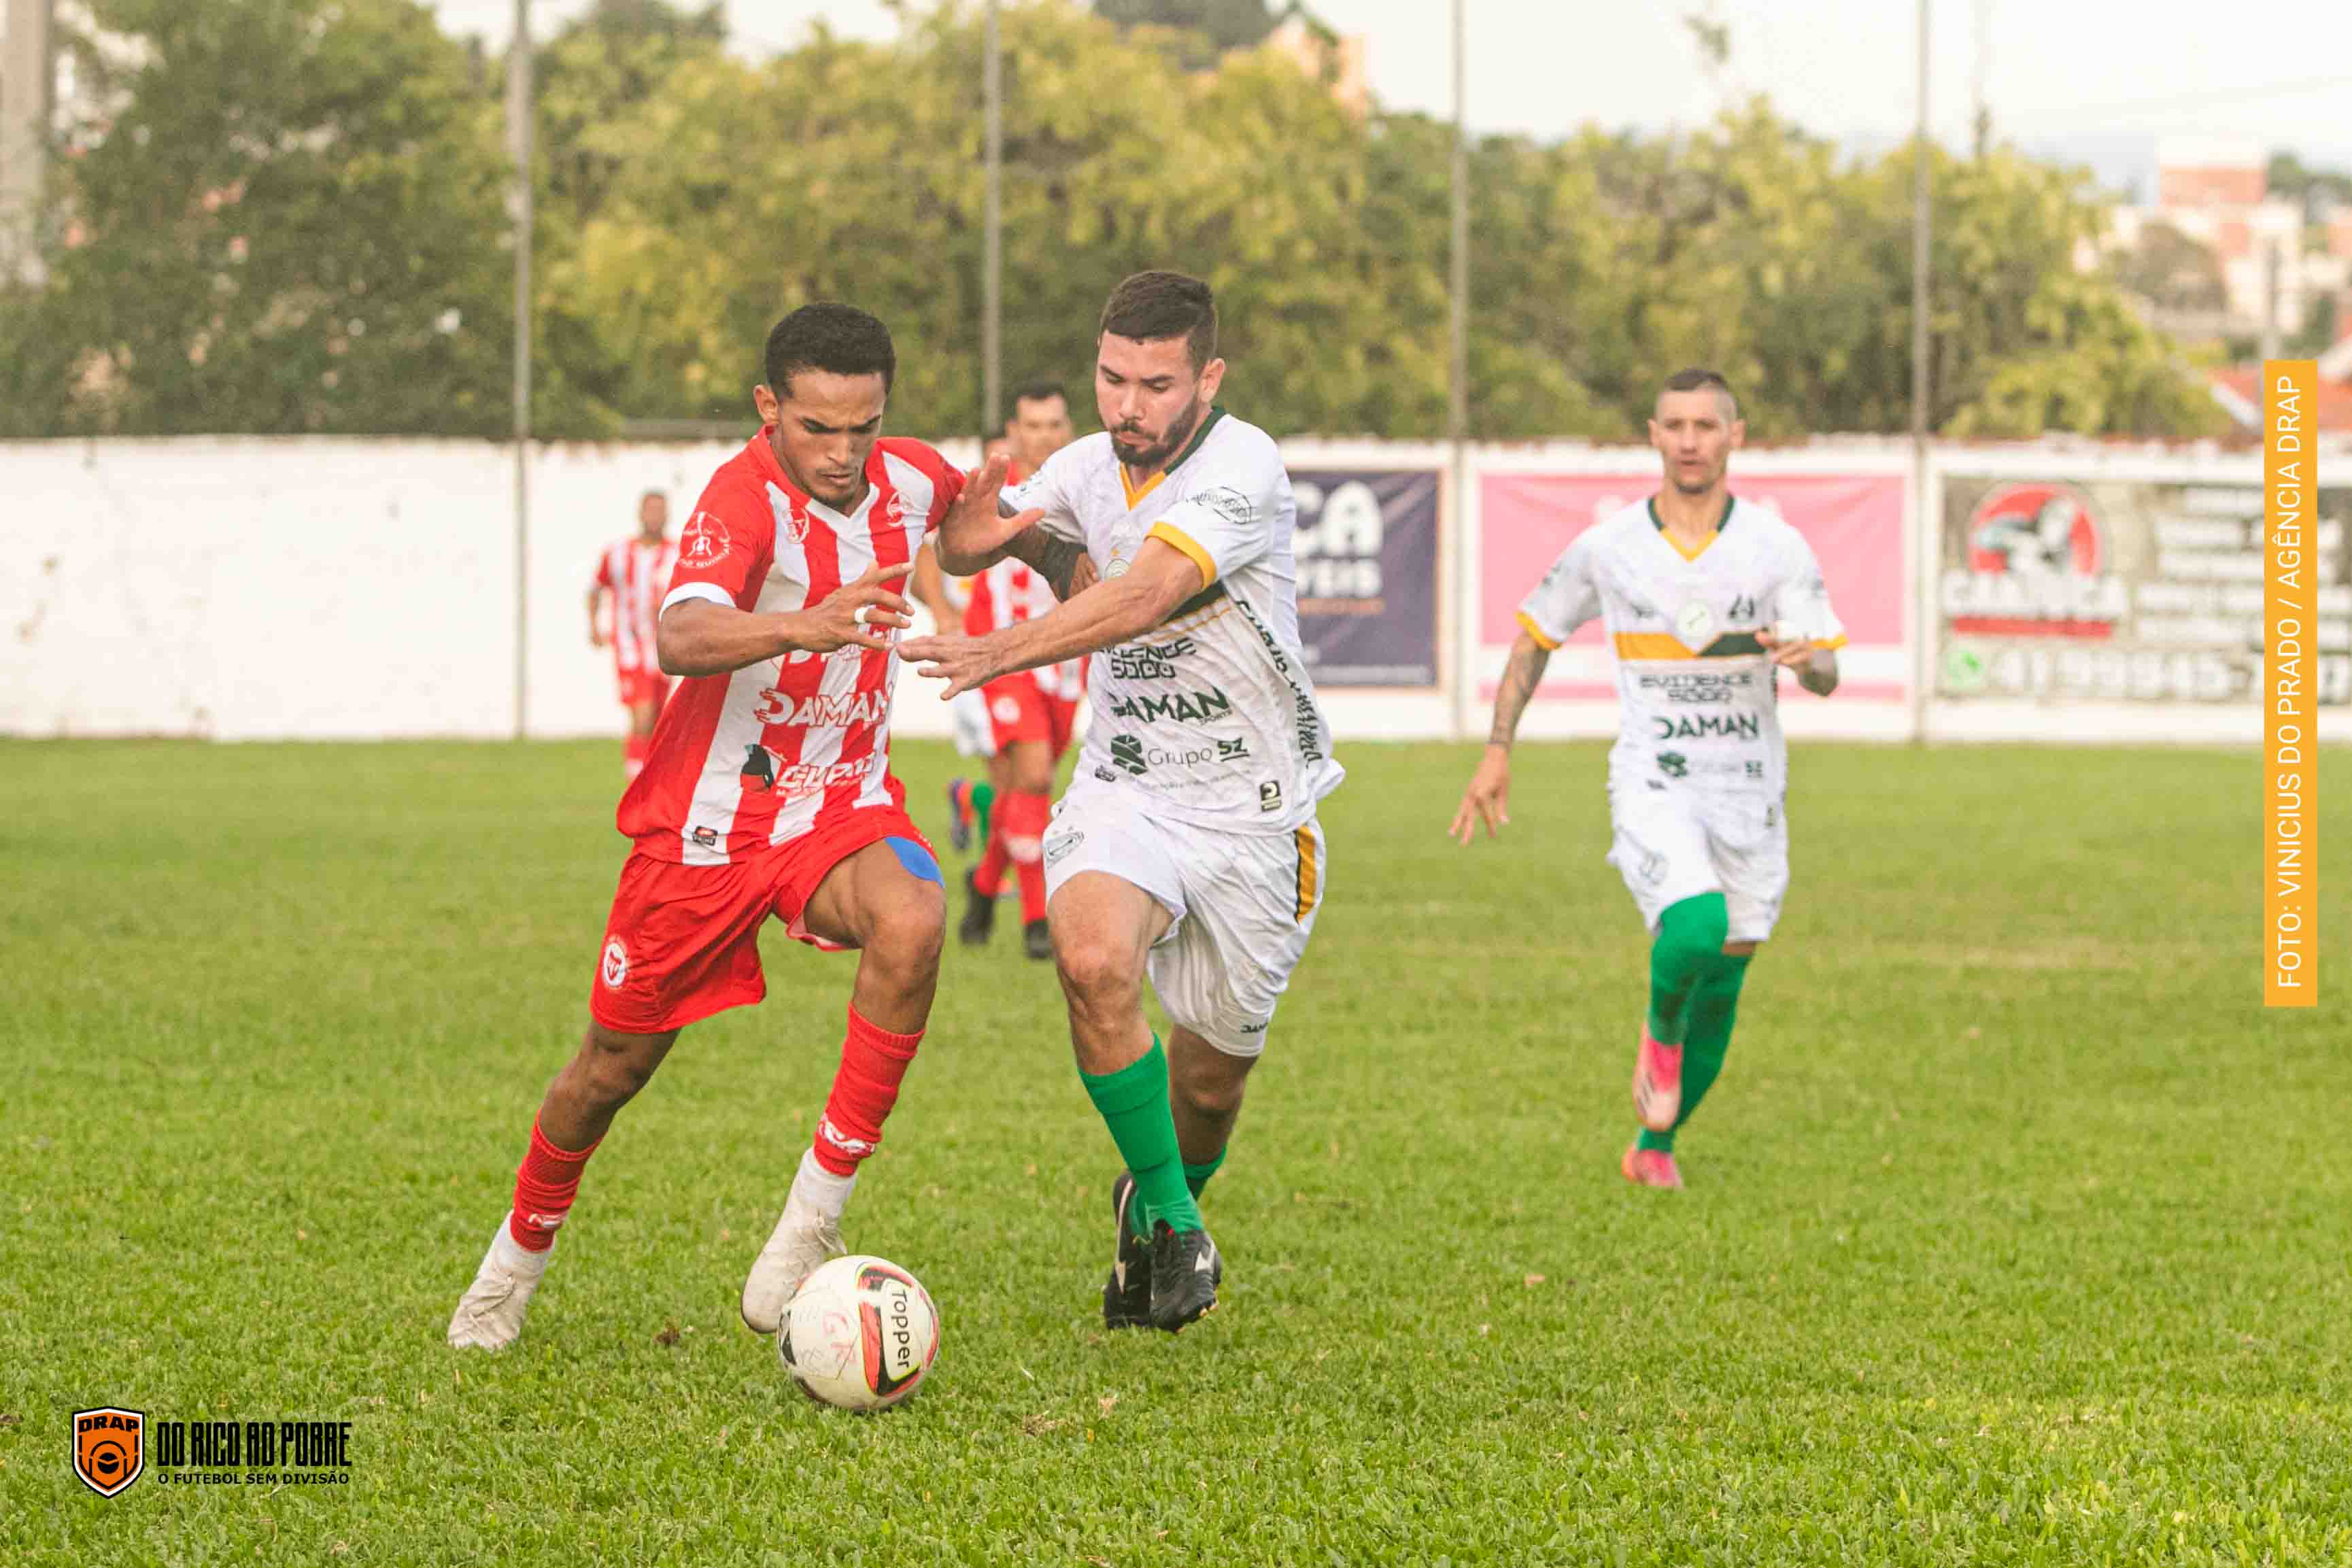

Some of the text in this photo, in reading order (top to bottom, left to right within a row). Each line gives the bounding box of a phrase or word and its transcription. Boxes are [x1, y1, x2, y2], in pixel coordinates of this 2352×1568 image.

[754, 687, 891, 728] DAMAN
[1652, 712, 1759, 741] DAMAN
[1147, 748, 1213, 768] Grupo
[891, 1289, 911, 1369] Topper
